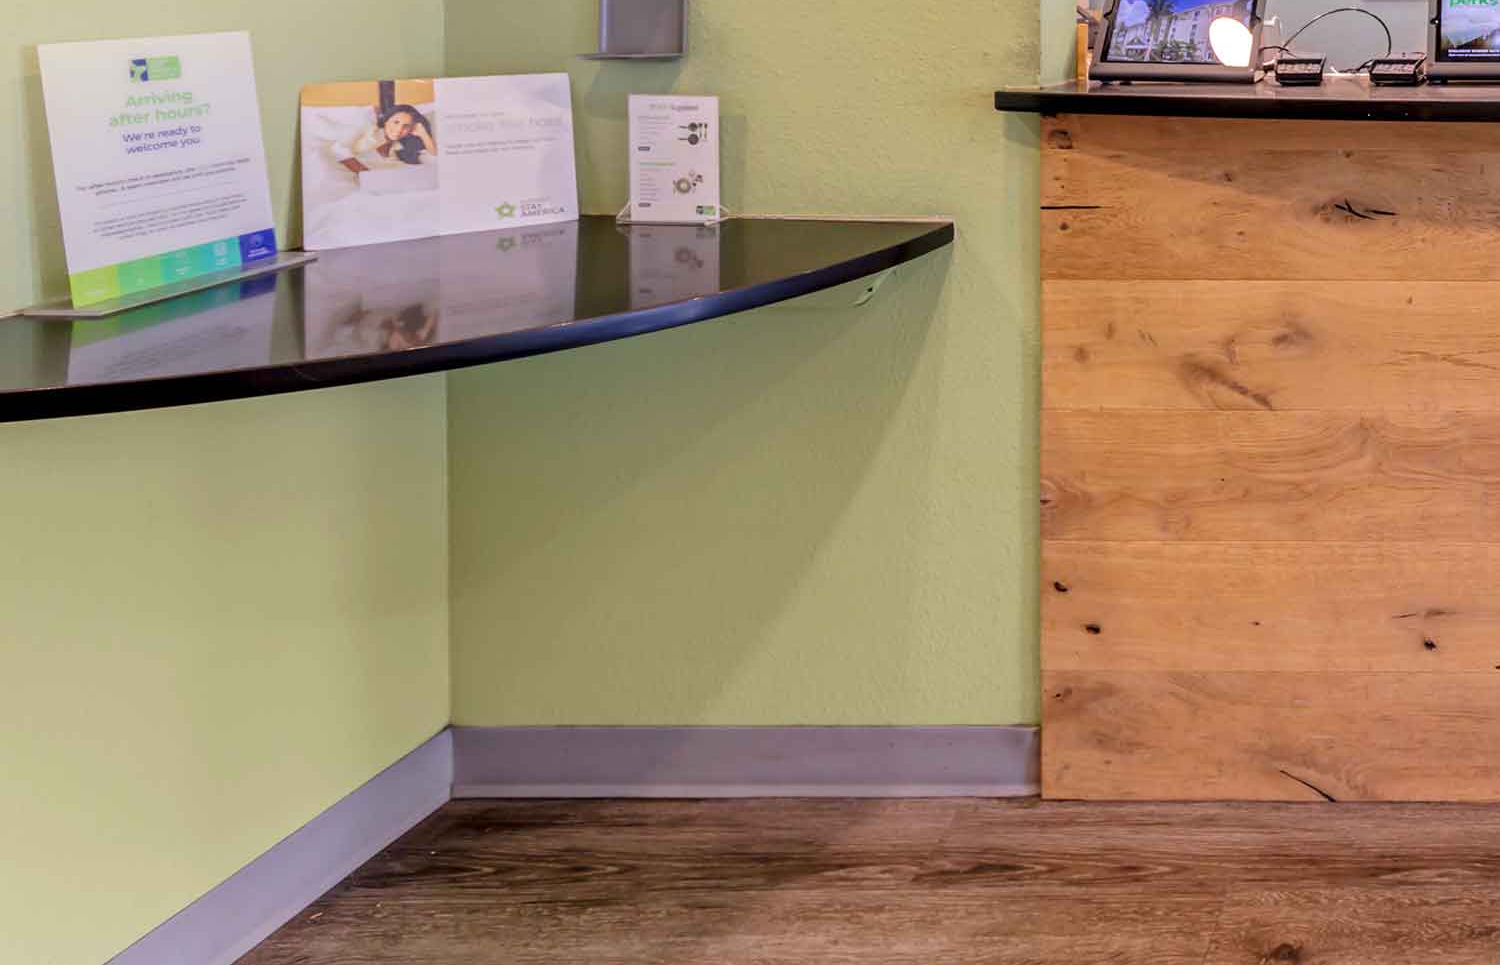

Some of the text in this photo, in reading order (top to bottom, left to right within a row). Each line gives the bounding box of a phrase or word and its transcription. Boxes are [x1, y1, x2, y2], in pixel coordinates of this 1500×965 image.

[126, 90, 193, 107] Arriving
[110, 111, 151, 127] after
[122, 131, 155, 143] We're
[158, 126, 189, 138] ready
[125, 140, 179, 154] welcome
